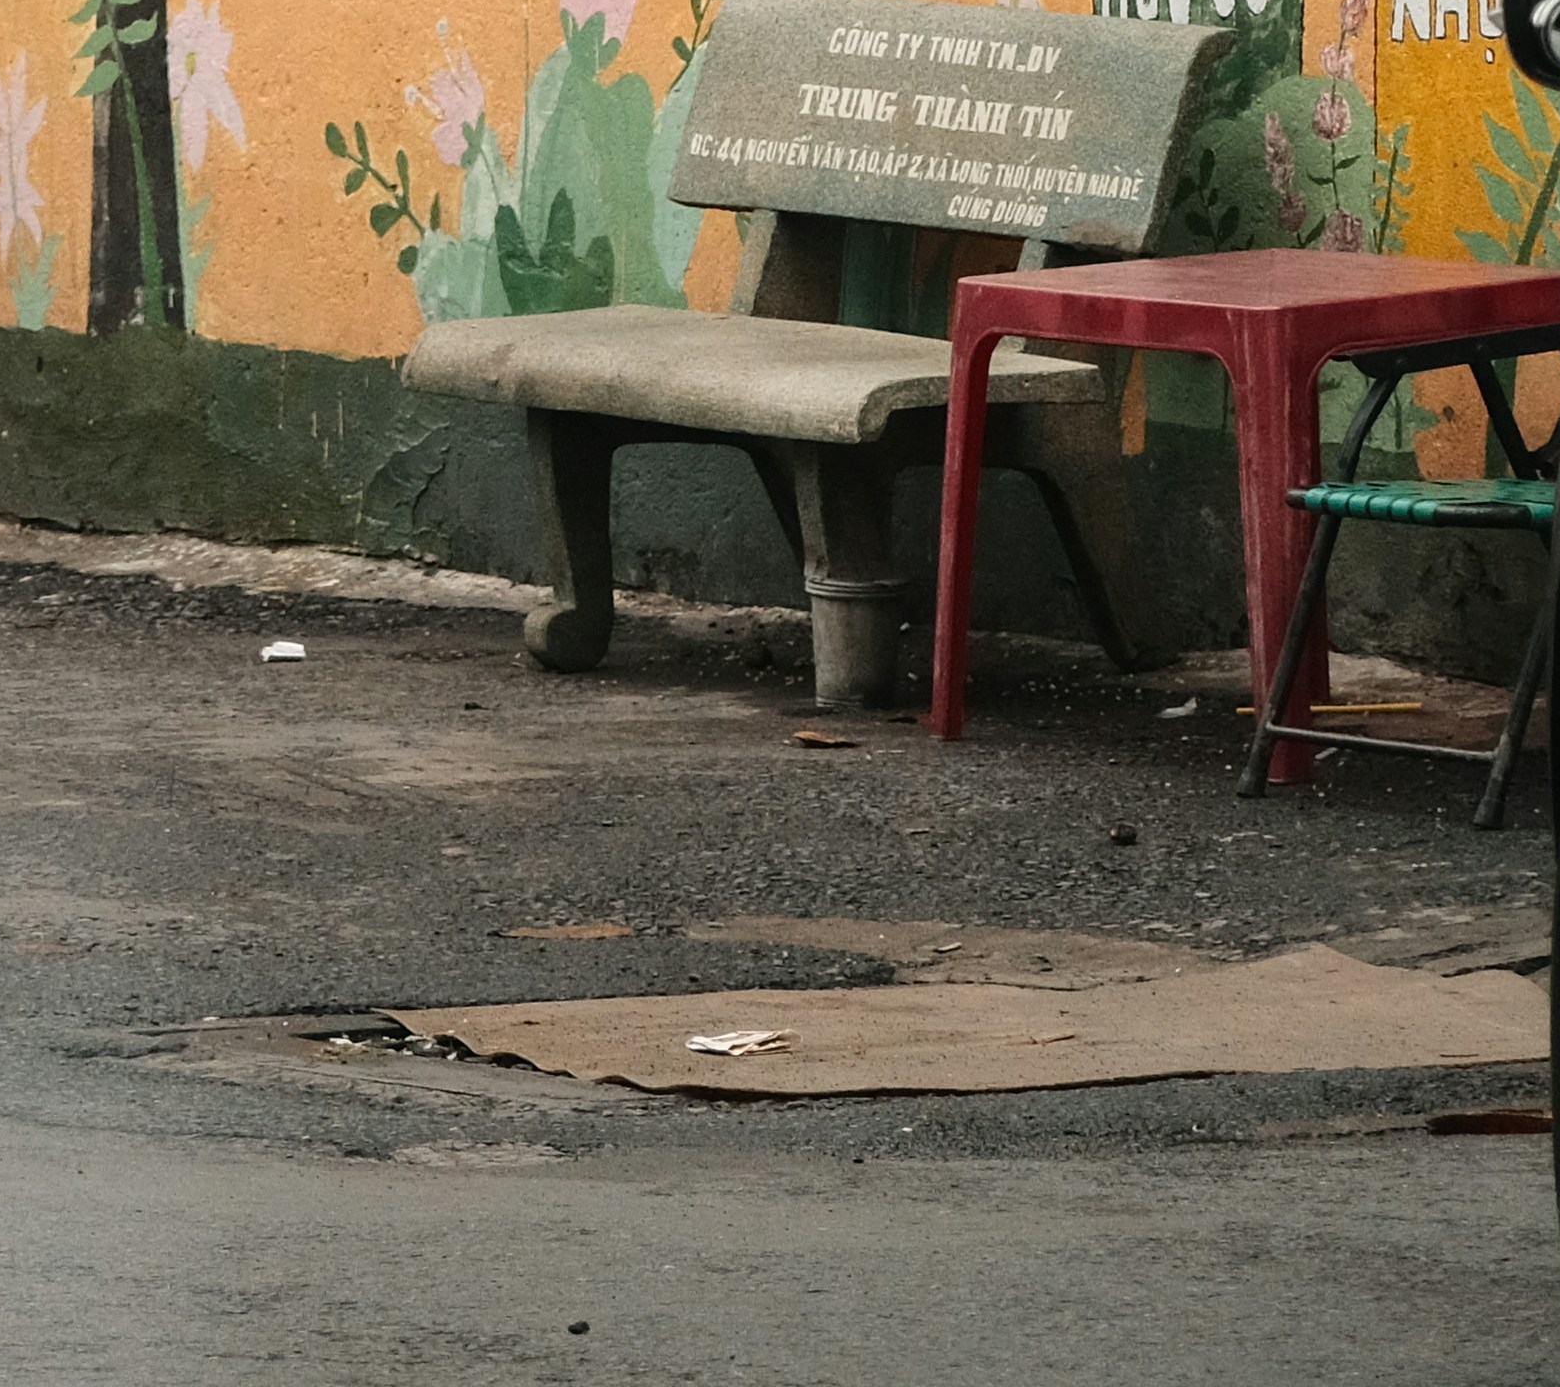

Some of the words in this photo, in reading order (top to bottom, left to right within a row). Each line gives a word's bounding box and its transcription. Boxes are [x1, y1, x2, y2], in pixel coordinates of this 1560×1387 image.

[828, 20, 889, 58] CÔNG
[894, 33, 926, 61] TY
[929, 36, 984, 67] TNHH
[798, 83, 898, 123] TRUNG
[912, 84, 1013, 135] THÀNH
[1017, 90, 1074, 141] TÍN
[950, 158, 993, 186] LONG
